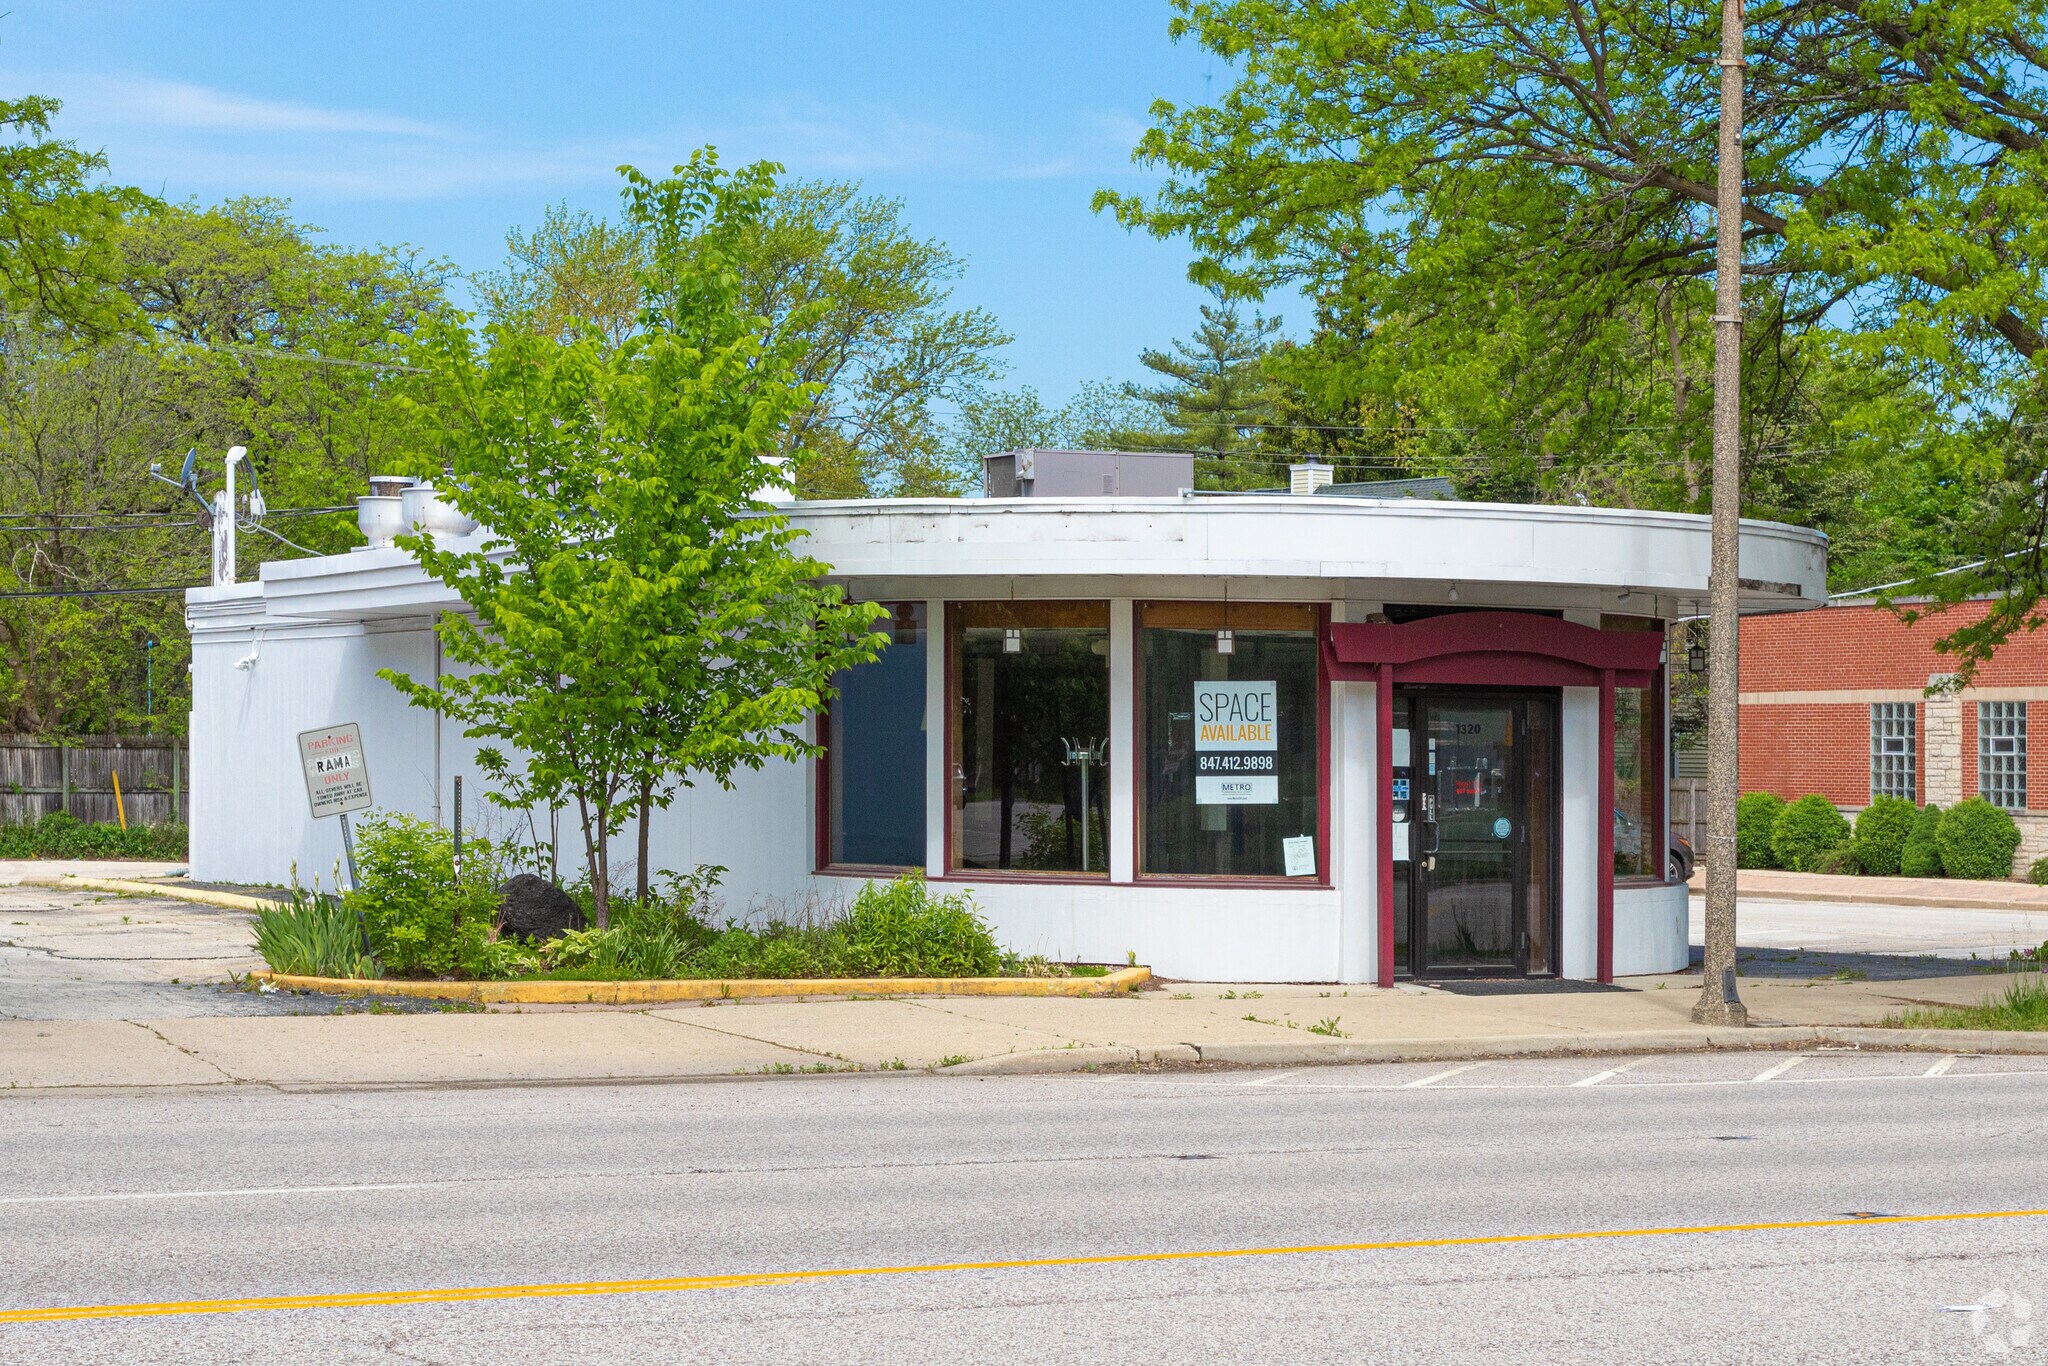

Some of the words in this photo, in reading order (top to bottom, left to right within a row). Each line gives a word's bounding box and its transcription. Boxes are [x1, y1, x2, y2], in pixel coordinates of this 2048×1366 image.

[1199, 692, 1272, 722] SPACE
[1200, 724, 1272, 741] AVAILABLE
[1456, 724, 1481, 735] 1320
[307, 734, 353, 751] PARKING
[316, 755, 351, 773] RAMA
[1200, 756, 1273, 770] 847.412.9898
[324, 772, 349, 785] ONLY
[325, 785, 343, 793] OTHERS
[1222, 783, 1251, 791] METRO
